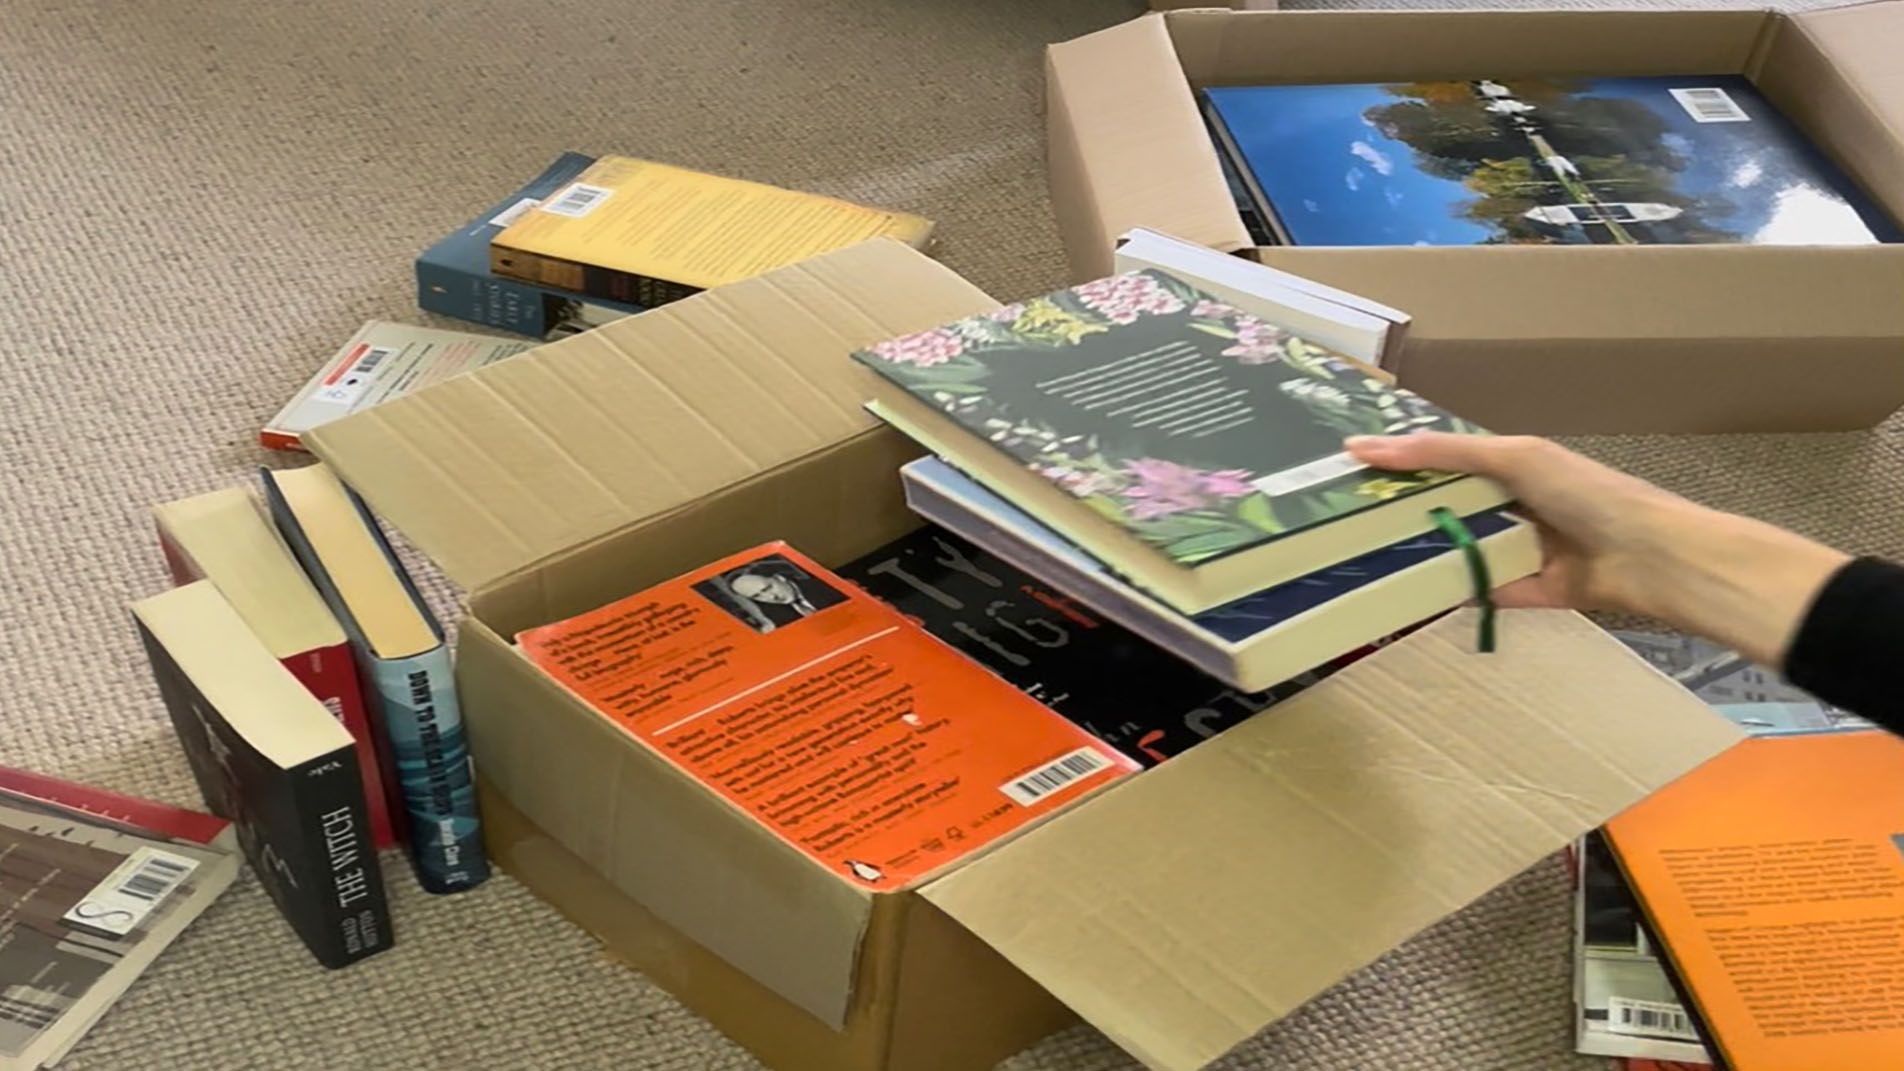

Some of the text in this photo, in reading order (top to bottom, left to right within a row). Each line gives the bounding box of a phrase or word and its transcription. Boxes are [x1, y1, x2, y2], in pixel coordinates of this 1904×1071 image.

[407, 670, 433, 705] DOWN
[414, 705, 436, 722] TO
[320, 806, 370, 909] THE WITCH
